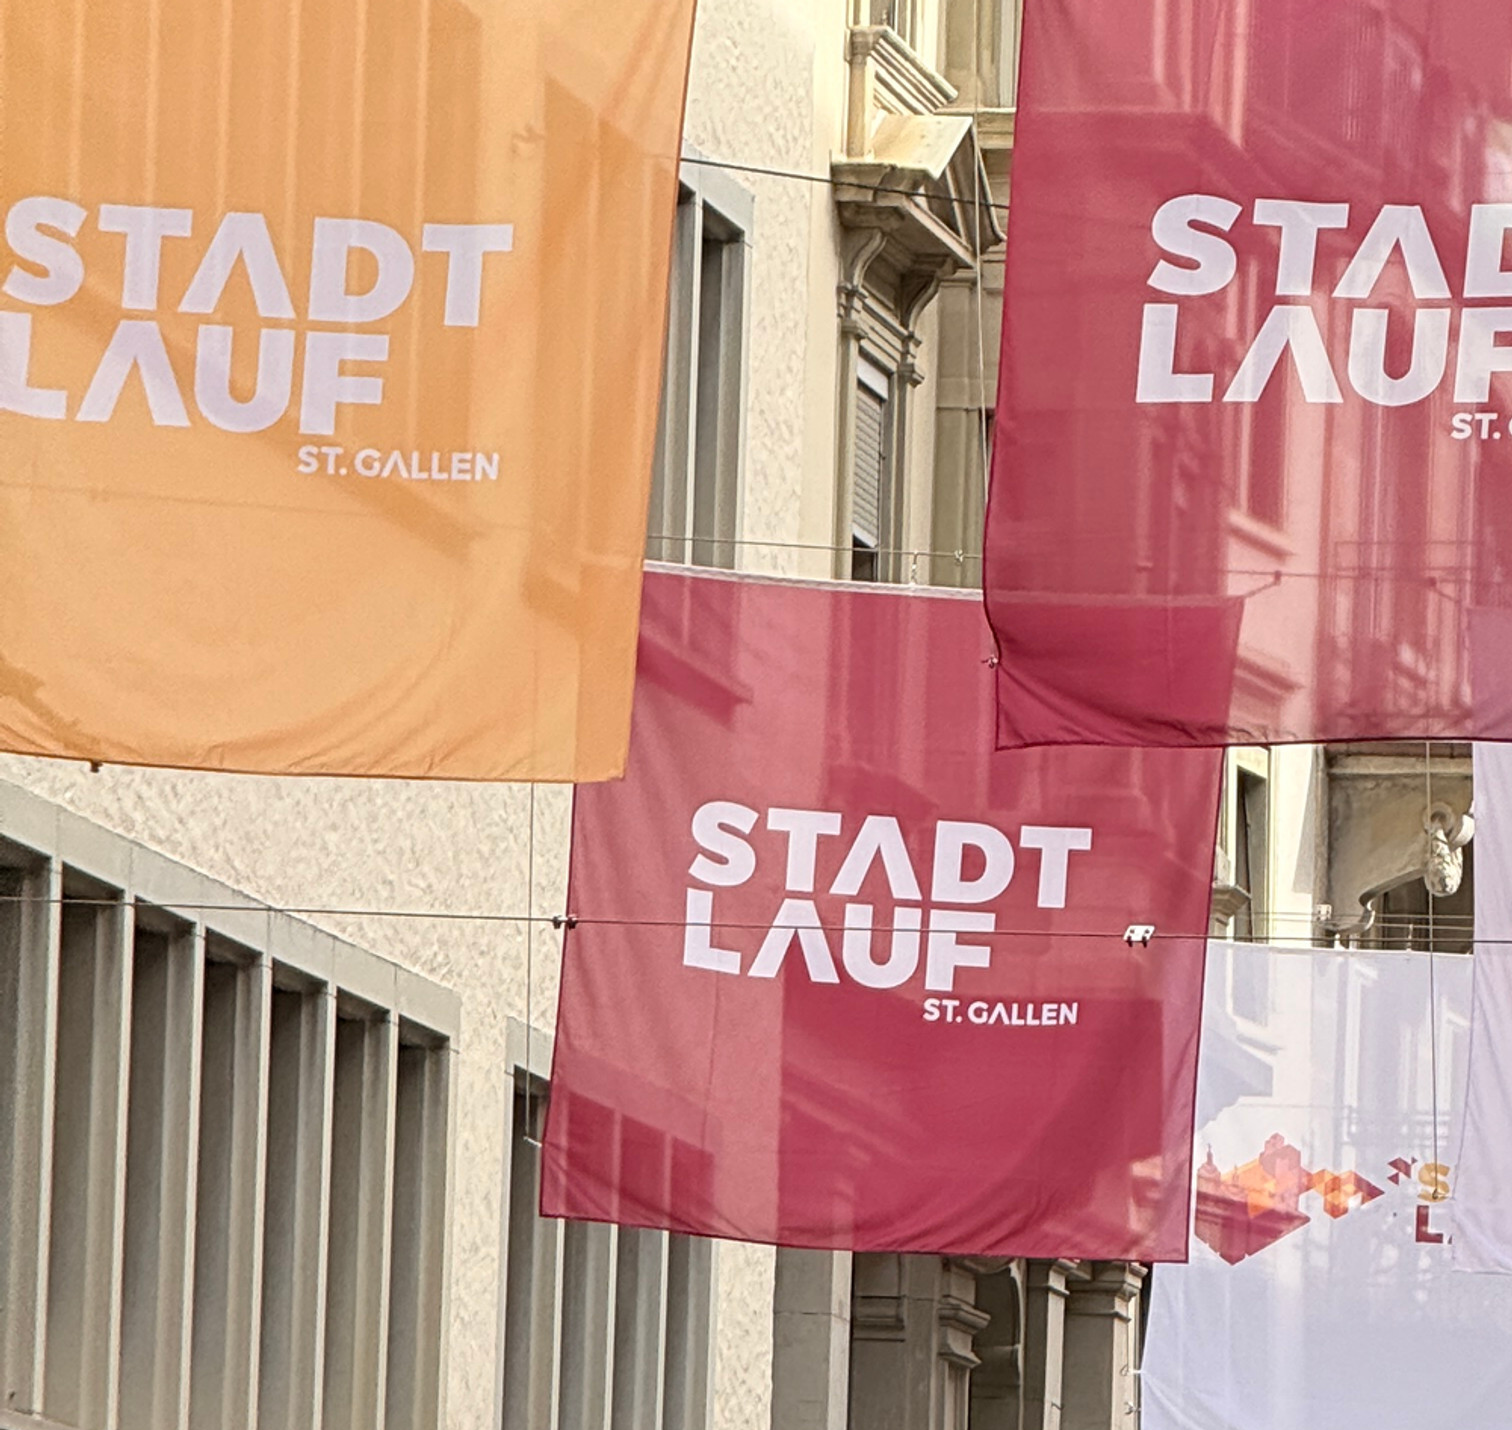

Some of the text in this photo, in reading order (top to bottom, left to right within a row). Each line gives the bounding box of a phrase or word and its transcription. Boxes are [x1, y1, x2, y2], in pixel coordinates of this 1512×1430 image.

[2, 195, 514, 328] STADT
[0, 310, 390, 436] LAUF
[297, 445, 500, 482] ST. GALLEN
[1450, 412, 1501, 441] ST.
[688, 801, 1092, 908] STADT
[683, 887, 996, 991] LAUF
[923, 998, 1078, 1026] ST. GALLEN
